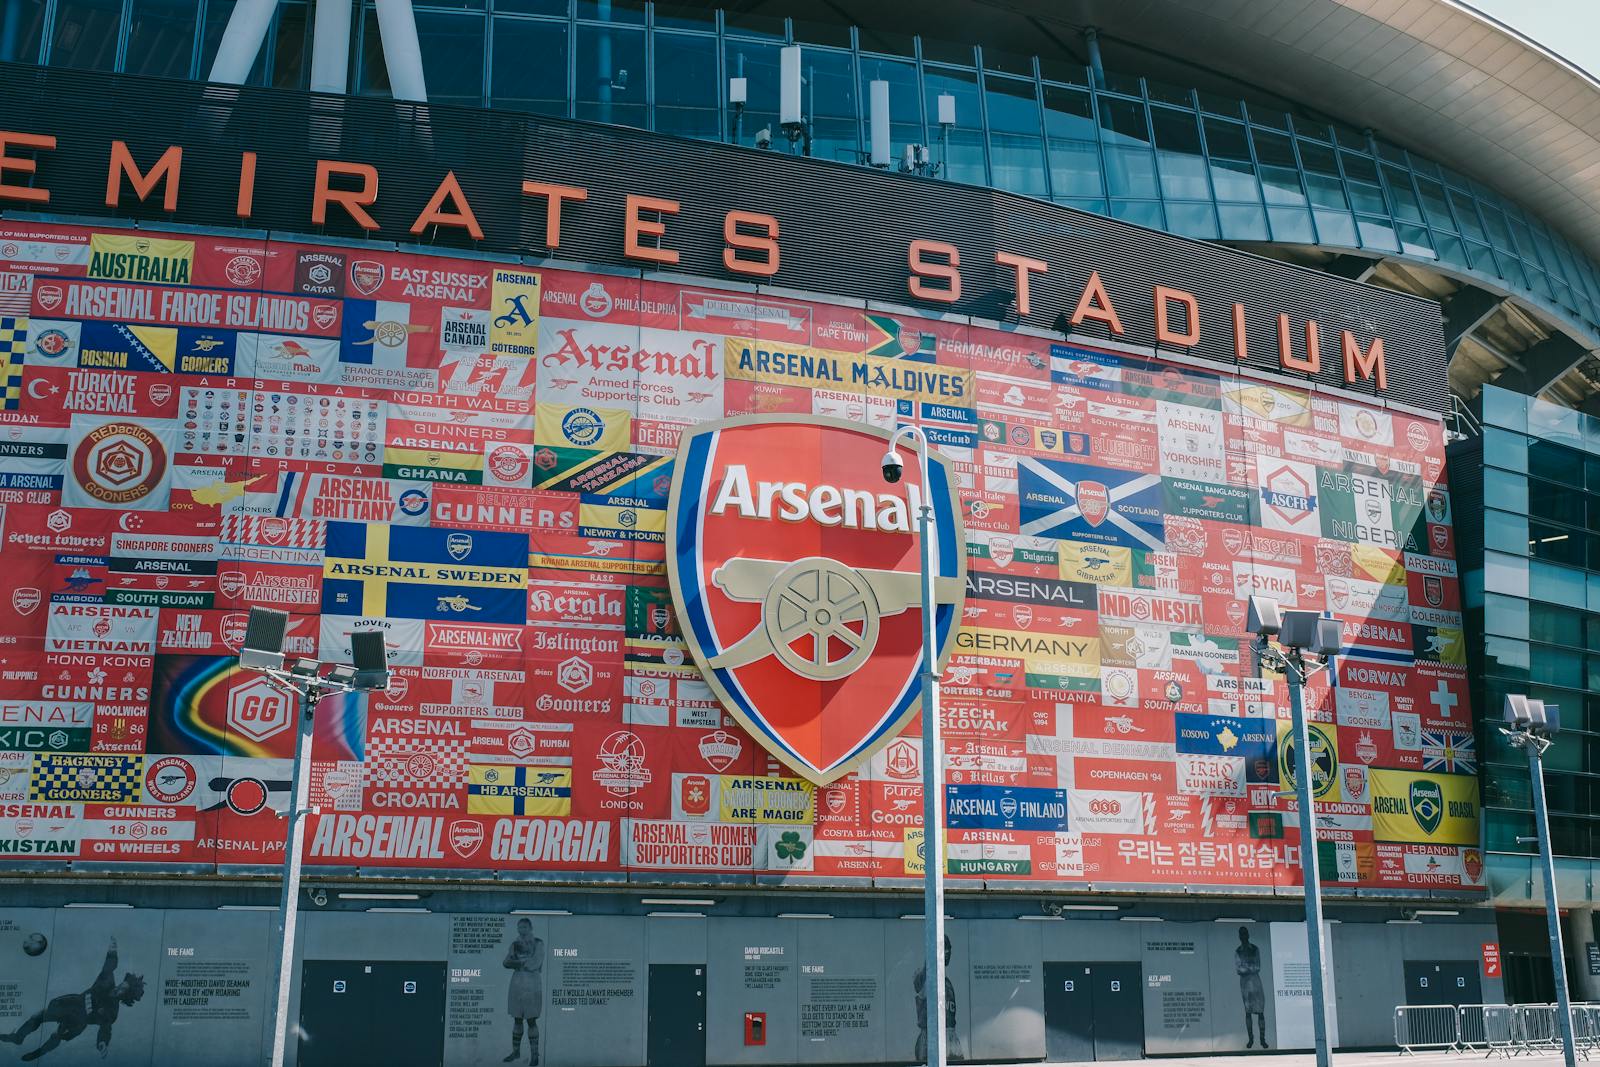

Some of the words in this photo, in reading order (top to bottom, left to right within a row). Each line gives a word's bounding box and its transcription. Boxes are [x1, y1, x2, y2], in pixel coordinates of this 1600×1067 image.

[0, 130, 780, 276] EMIRATES
[908, 239, 1387, 390] STADIUM
[89, 252, 189, 284] AUSTRALIA
[391, 267, 429, 282] EAST
[431, 272, 488, 289] SUSSEX
[496, 272, 538, 286] ARSENAL
[302, 283, 336, 294] QATAR
[402, 284, 476, 302] ARSENAL
[64, 284, 155, 320] ARSENAL
[161, 290, 222, 325] FAROE
[225, 295, 311, 332] ISLANDS
[543, 290, 577, 305] ARSENAL
[614, 298, 677, 316] PHILADELPHIA
[444, 320, 487, 335] ARSENAL
[818, 327, 845, 340] CAPE
[846, 330, 869, 343] TOWN
[444, 331, 486, 346] CANADA
[542, 328, 719, 380] Arsenal
[939, 338, 1021, 363] FERMANAGH
[738, 347, 844, 384] ARSENAL
[852, 361, 964, 398] MALDIVES
[67, 370, 138, 394] TÜRKİYE
[588, 376, 630, 389] Armed
[633, 380, 674, 394] Forces
[63, 392, 137, 414] ARSENAL
[392, 392, 458, 407] NORTH
[466, 399, 530, 413] WALES
[581, 387, 650, 403] Supporters
[653, 394, 680, 406] Club
[814, 390, 863, 404] ARSENAL
[865, 396, 896, 409] DELHI
[930, 406, 969, 421] ARSENAL
[414, 423, 507, 440] GUNNERS
[1168, 419, 1216, 434] ARSENAL
[90, 424, 154, 446] REDaction
[928, 430, 971, 445] Iceland
[391, 437, 478, 453] ARSENAL
[1163, 450, 1222, 469] YORKSHIRE
[397, 467, 467, 482] GHANA
[318, 477, 392, 501] ARSENAL
[1173, 481, 1203, 492] ARSENAL
[1204, 484, 1250, 499] BANGLADESH
[476, 492, 536, 508] BELFAST
[607, 496, 649, 508] ARSENAL
[710, 463, 923, 534] Arsenal
[1026, 493, 1065, 505] ARSENAL
[1118, 504, 1160, 517] SCOTLAND
[312, 497, 396, 521] BRITTANY
[436, 503, 574, 528] GUNNERS
[584, 527, 617, 538] NEWRY
[619, 531, 626, 539] &
[627, 531, 665, 542] MOURN
[1332, 519, 1418, 551] NIGERIA
[116, 539, 170, 551] SINGAPORE
[172, 542, 214, 553] GOONERS
[221, 545, 321, 562] ARGENTINA
[59, 556, 105, 564] ARSENAL
[135, 560, 192, 572] ARSENAL
[1408, 558, 1455, 574] ARSENAL
[330, 563, 430, 579] ARSENAL
[437, 569, 522, 584] SWEDEN
[964, 575, 1084, 604] ARSENAL
[1252, 574, 1294, 594] SYRIA
[116, 593, 158, 604] SOUTH
[162, 595, 204, 606] SUDAN
[530, 589, 622, 617] Kerala
[53, 605, 154, 619] ARSENAL
[176, 614, 202, 631] NEW
[161, 630, 212, 649] ZEALAND
[1343, 621, 1405, 643] ARSENAL
[53, 639, 150, 652] VIETNAM
[533, 630, 619, 654] Islington
[956, 632, 1088, 657] GERMANY
[47, 654, 96, 666] HONG
[103, 656, 151, 668] KONG
[1172, 647, 1203, 657] IRANIAN
[1205, 651, 1238, 661] GOONERS
[423, 667, 471, 679] NORFOLK
[476, 669, 525, 681] ARSENAL
[1153, 671, 1191, 683] ARSENAL
[1347, 667, 1407, 688] NORWAY
[42, 684, 149, 701] GUNNERS
[1216, 679, 1266, 691] ARSENAL
[631, 696, 655, 706] THE
[660, 698, 714, 709] ARSENAL
[1348, 691, 1376, 701] BENGAL
[96, 705, 147, 717] WOOLWICH
[241, 695, 280, 723] GG
[421, 704, 489, 717] SUPPORTERS
[495, 707, 522, 718] CLUB
[1144, 699, 1173, 711] SOUTH
[1175, 701, 1203, 713] AFRICA
[371, 717, 466, 736] ARSENAL
[472, 736, 504, 746] ARSENAL
[539, 739, 570, 748] MUMBAI
[1181, 729, 1209, 740] KOSOVO
[1241, 731, 1275, 743] ARSENAL
[51, 755, 126, 768] HACKNEY
[1090, 769, 1148, 781] COPENHAGEN
[480, 785, 498, 795] HB
[502, 785, 559, 798] ARSENAL
[731, 779, 803, 792] ARSENAL
[1185, 779, 1238, 790] GUNNERS
[372, 791, 459, 809] CROATIA
[600, 800, 643, 811] LONDON
[949, 797, 998, 816] ARSENAL
[1020, 801, 1065, 819] FINLAND
[1374, 797, 1408, 815] ARSENAL
[1448, 801, 1475, 819] BRASIL
[103, 806, 176, 818] GUNNERS
[731, 808, 757, 819] ARE
[762, 809, 804, 820] MAGIC
[309, 813, 445, 859] ARSENAL
[490, 818, 611, 864] GEORGIA
[632, 823, 689, 844] ARSENAL
[710, 825, 757, 846] WOMEN
[823, 828, 855, 838] COSTA
[856, 829, 895, 839] BLANCA
[962, 831, 1015, 842] ARSENAL
[93, 842, 115, 853] ON
[119, 842, 181, 855] WHEELS
[636, 843, 718, 866] SUPPORTERS
[721, 846, 752, 866] CLUB
[1118, 840, 1174, 865] 우리는
[1179, 841, 1233, 867] 잠들지
[1405, 845, 1456, 856] LEBANON
[837, 860, 882, 869] ARSENAL
[960, 861, 1018, 873] HUNGARY
[1407, 874, 1460, 884] GUNNERS
[554, 949, 563, 957] THE
[565, 949, 577, 957] FANS
